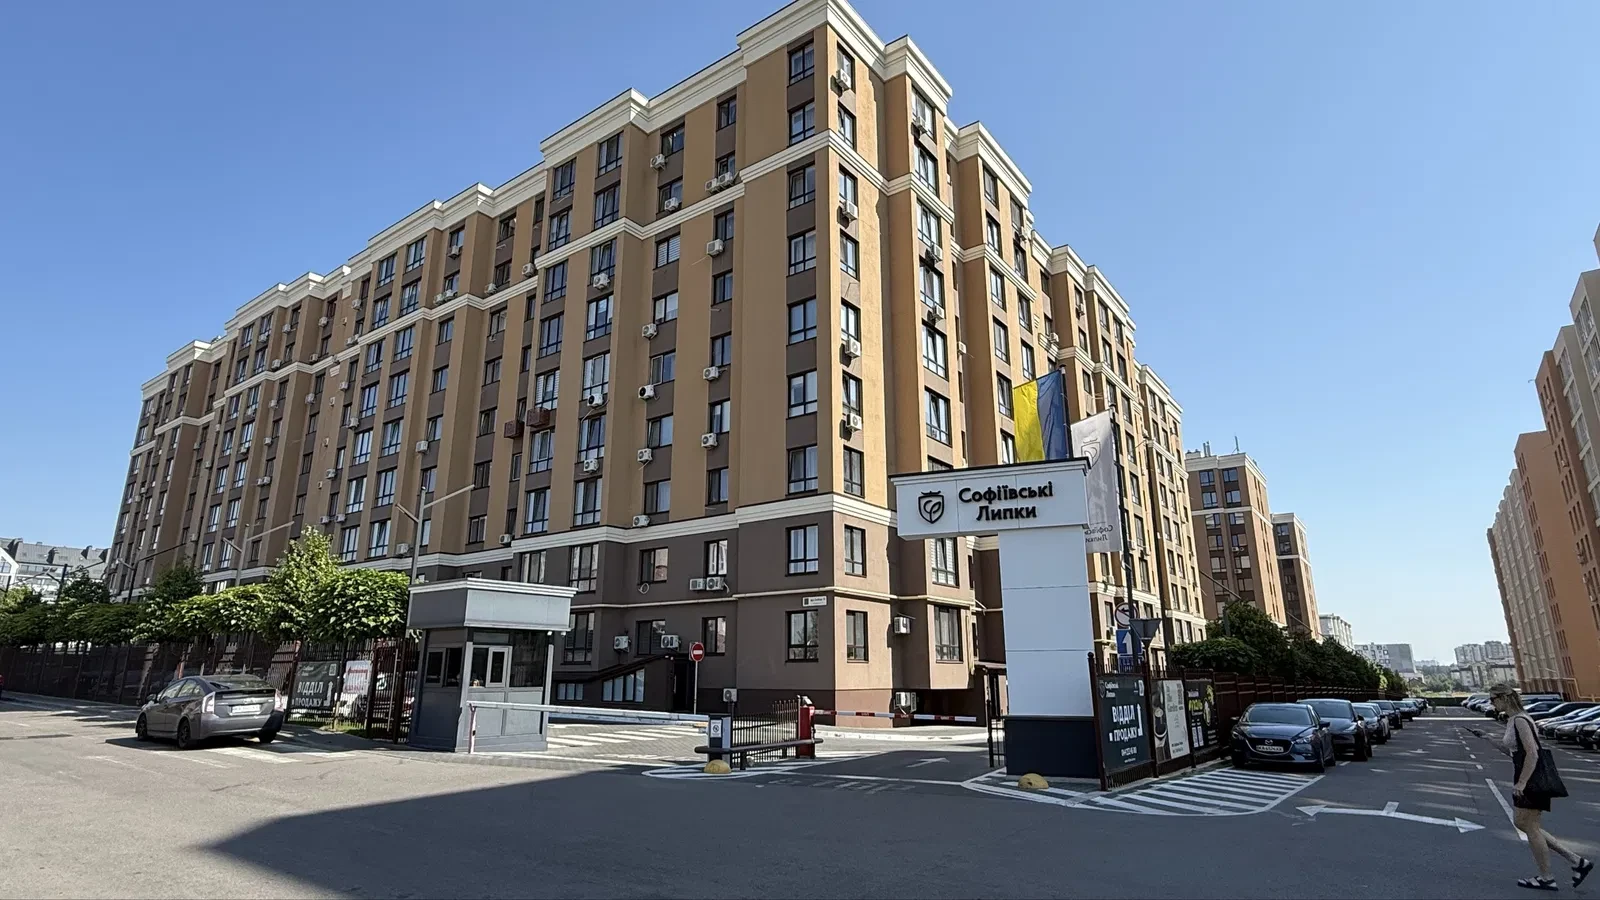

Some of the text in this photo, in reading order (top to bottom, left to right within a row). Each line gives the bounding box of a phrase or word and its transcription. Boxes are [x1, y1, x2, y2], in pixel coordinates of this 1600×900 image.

[958, 481, 1053, 504] Софіївські
[976, 505, 1037, 521] Липки
[297, 681, 324, 696] ВІДДІЛ
[1111, 704, 1136, 725] ВІДДІЛ
[1113, 726, 1138, 742] ПРОДАЖУ
